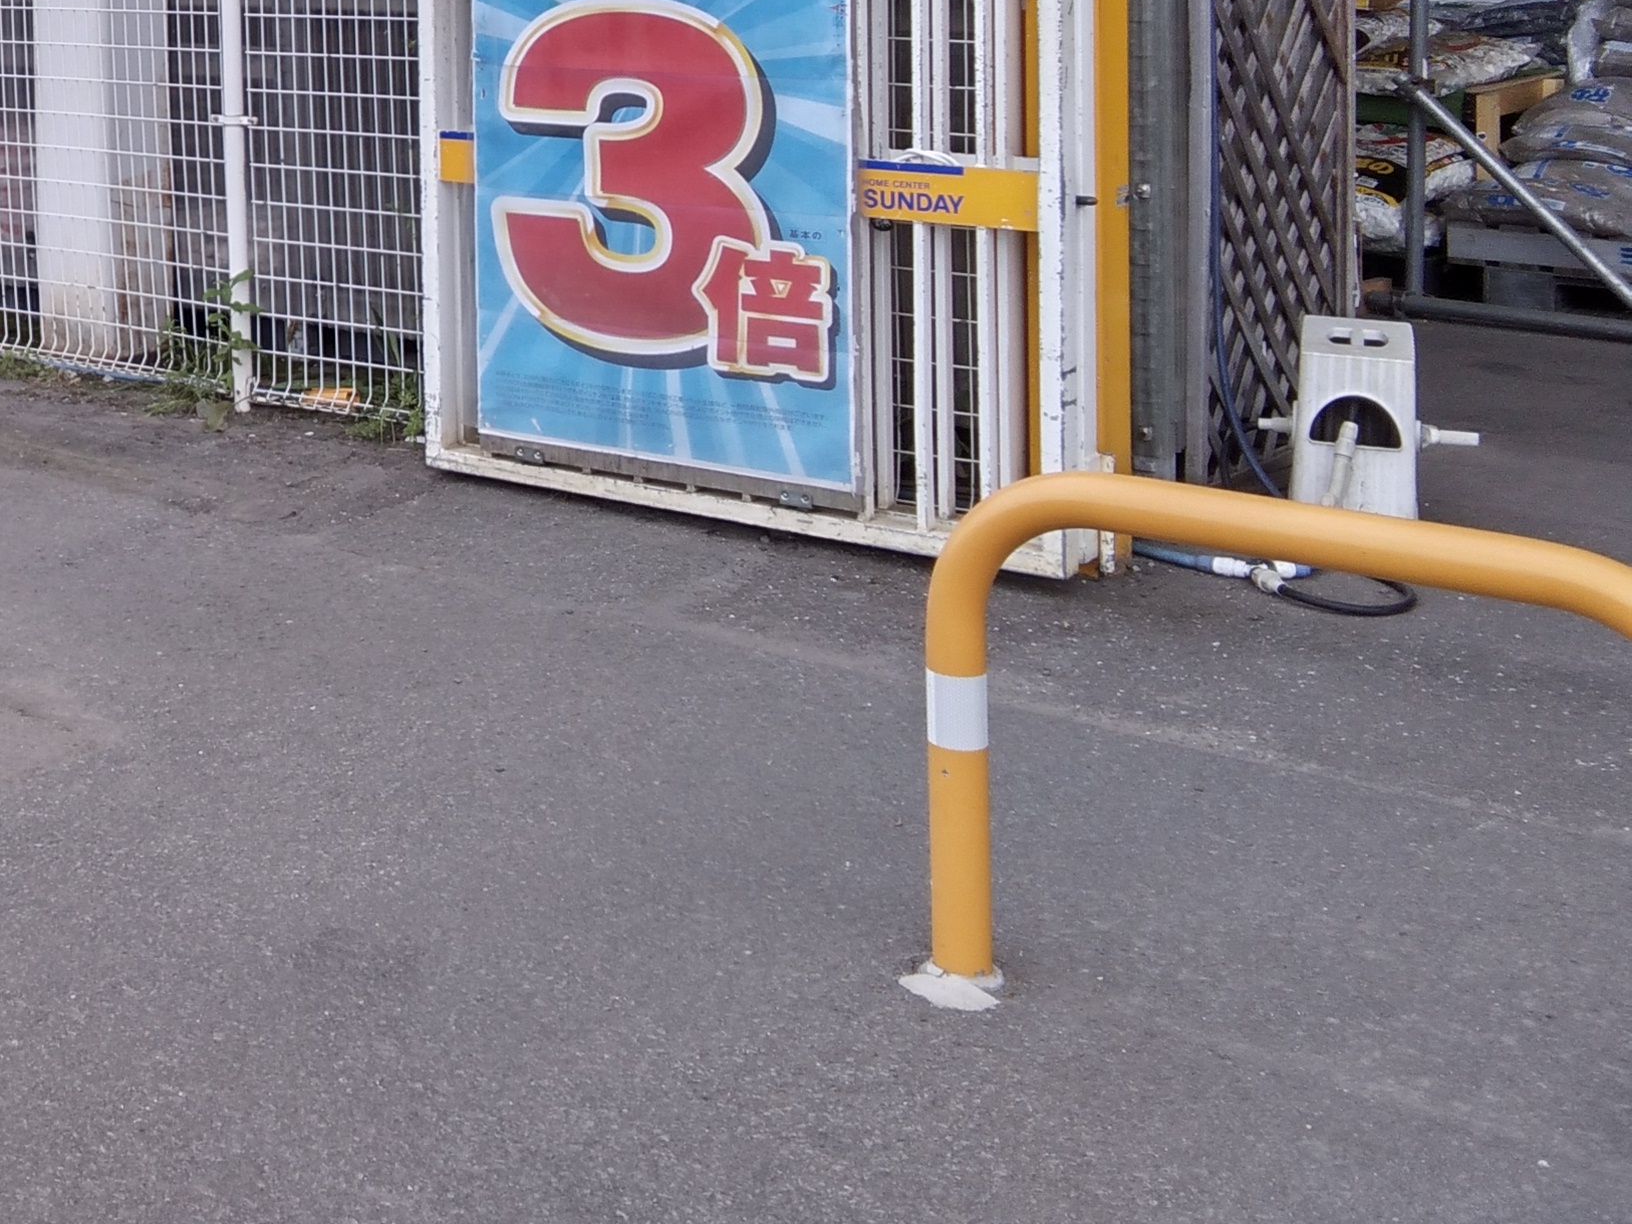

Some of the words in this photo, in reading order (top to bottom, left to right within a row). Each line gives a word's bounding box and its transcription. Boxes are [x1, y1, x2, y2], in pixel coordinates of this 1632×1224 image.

[862, 178, 889, 188] HOME
[893, 179, 931, 190] CENTER
[863, 188, 965, 214] SUNDAY
[788, 229, 823, 241] 基本の
